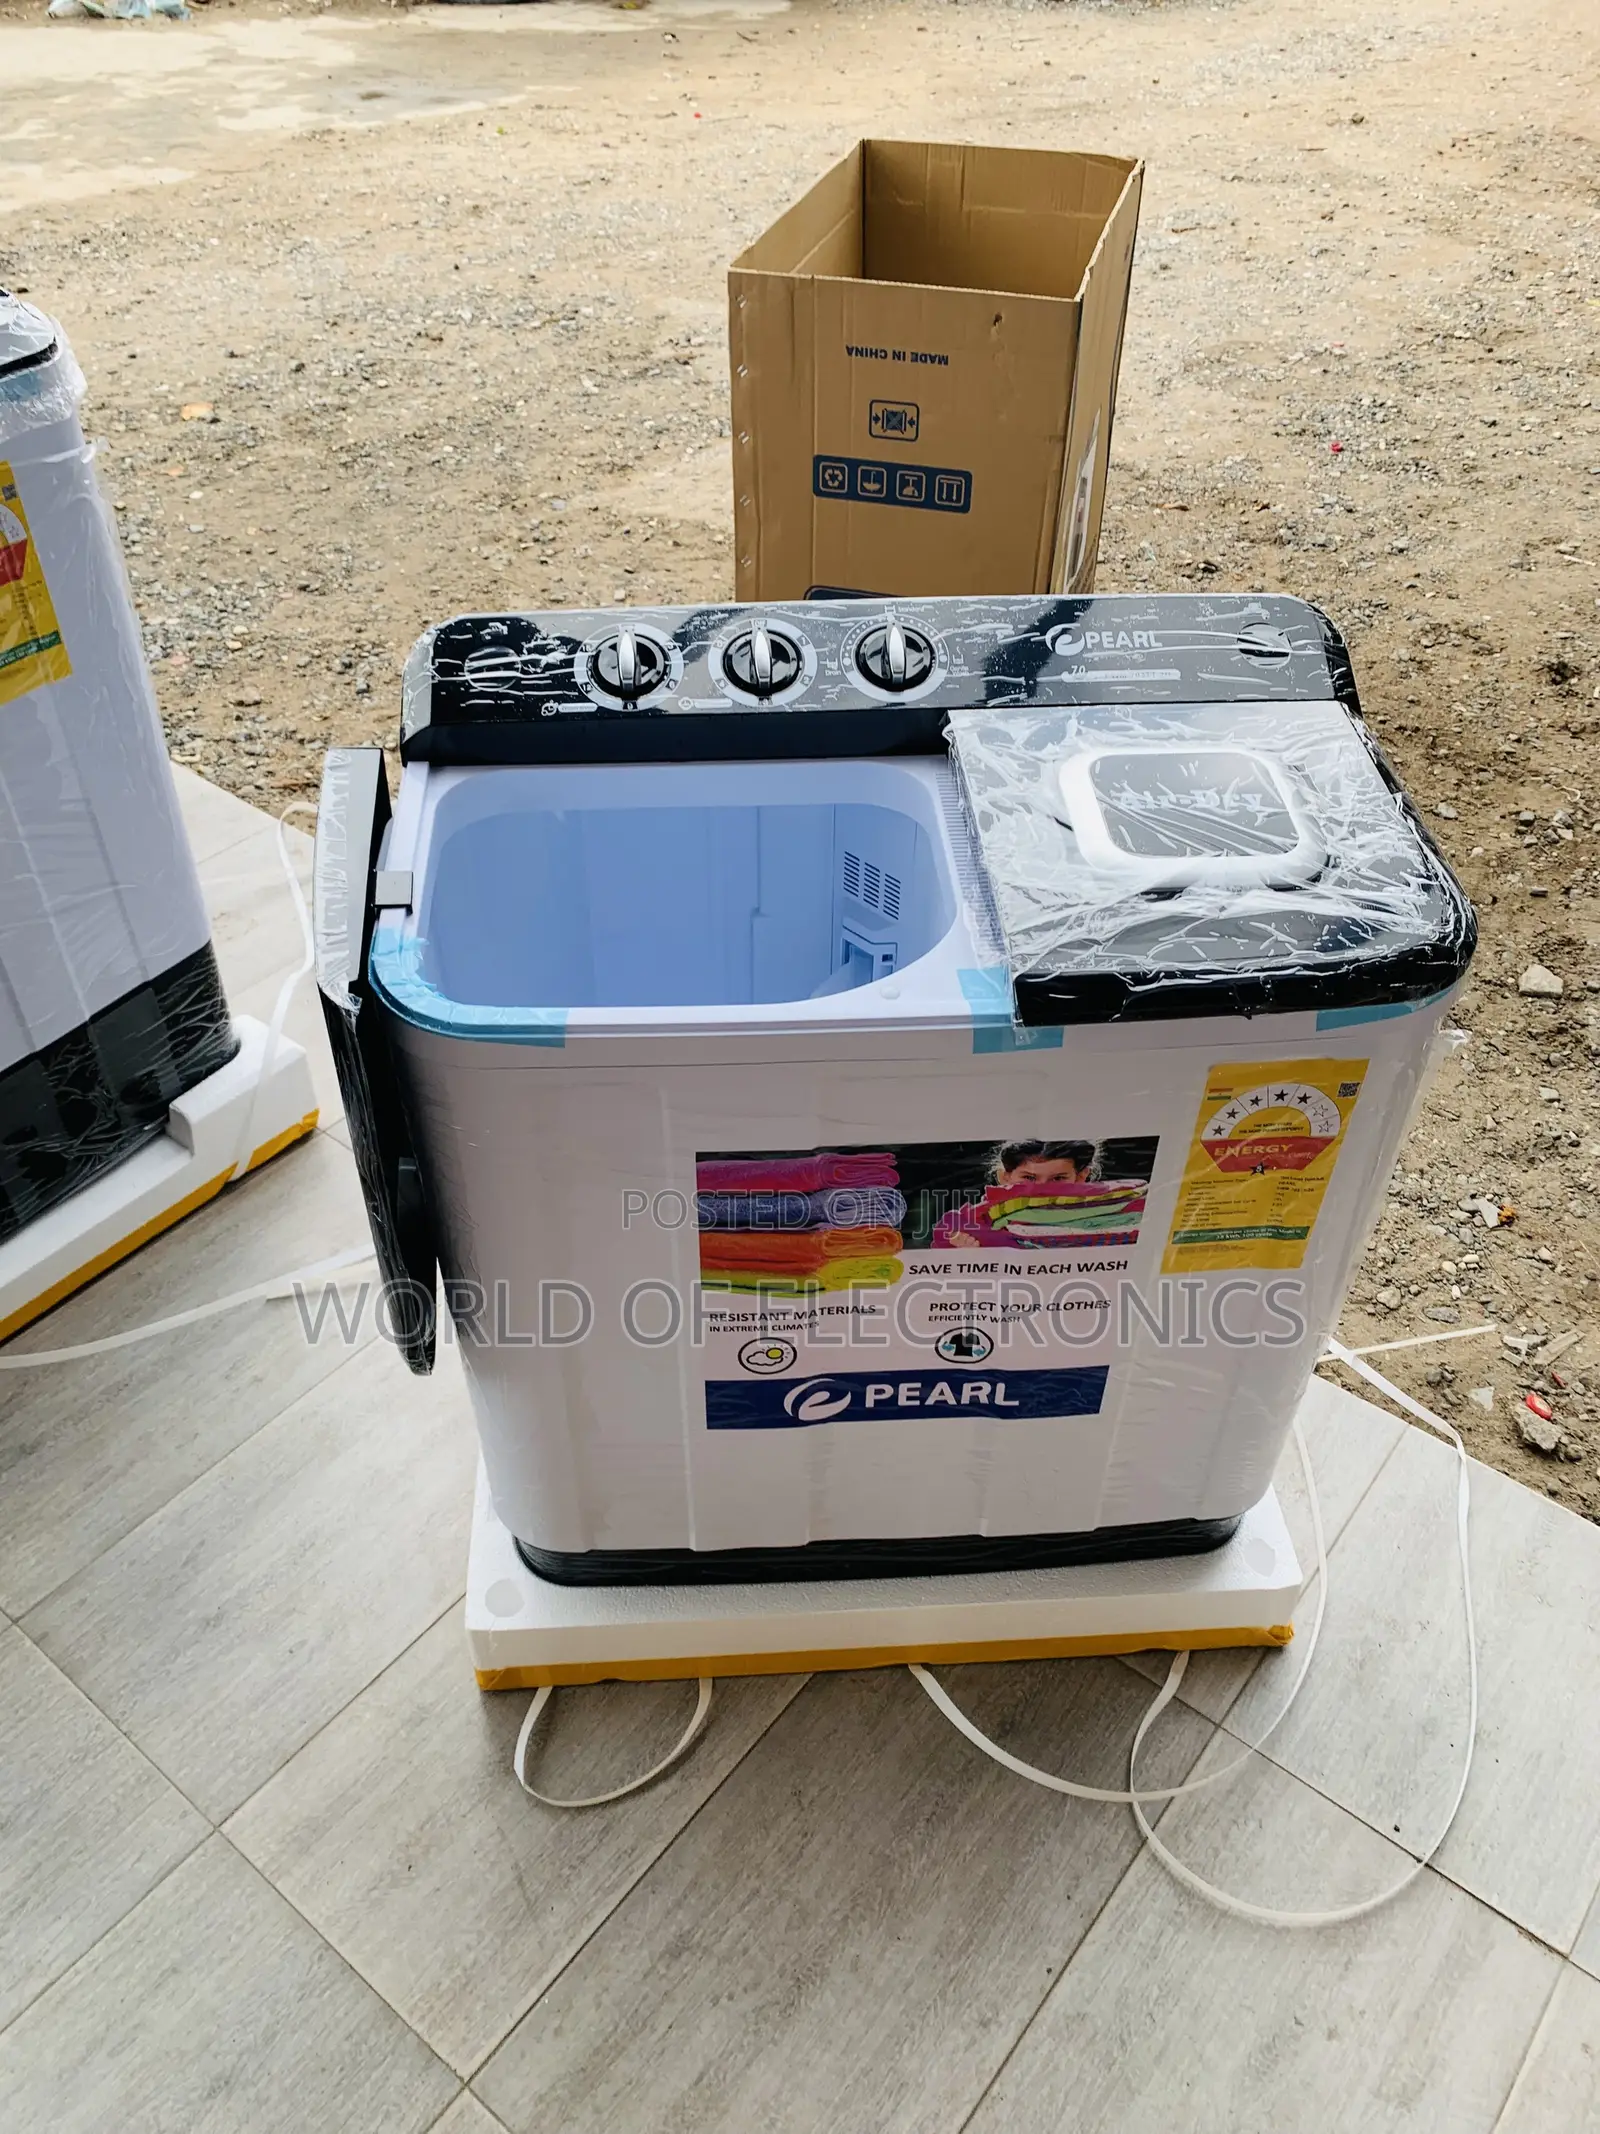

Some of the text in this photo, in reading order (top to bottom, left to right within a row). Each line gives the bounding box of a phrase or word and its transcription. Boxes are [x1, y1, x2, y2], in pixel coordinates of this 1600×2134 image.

[845, 344, 949, 366] MADE IN CHINA
[1085, 630, 1163, 648] PEARL
[1214, 1143, 1294, 1158] ENERGY
[909, 1260, 1129, 1275] SAVE TIME IN EACH WASH
[709, 1304, 876, 1322] RESISTANT MATERIALS
[929, 1300, 1112, 1313] PROTECT YOUR CLOTHES
[928, 1314, 987, 1322] EFFICIENTLY
[723, 1324, 769, 1332] EXTREME
[771, 1321, 820, 1332] CLIMATES
[865, 1381, 1020, 1408] PEARL
